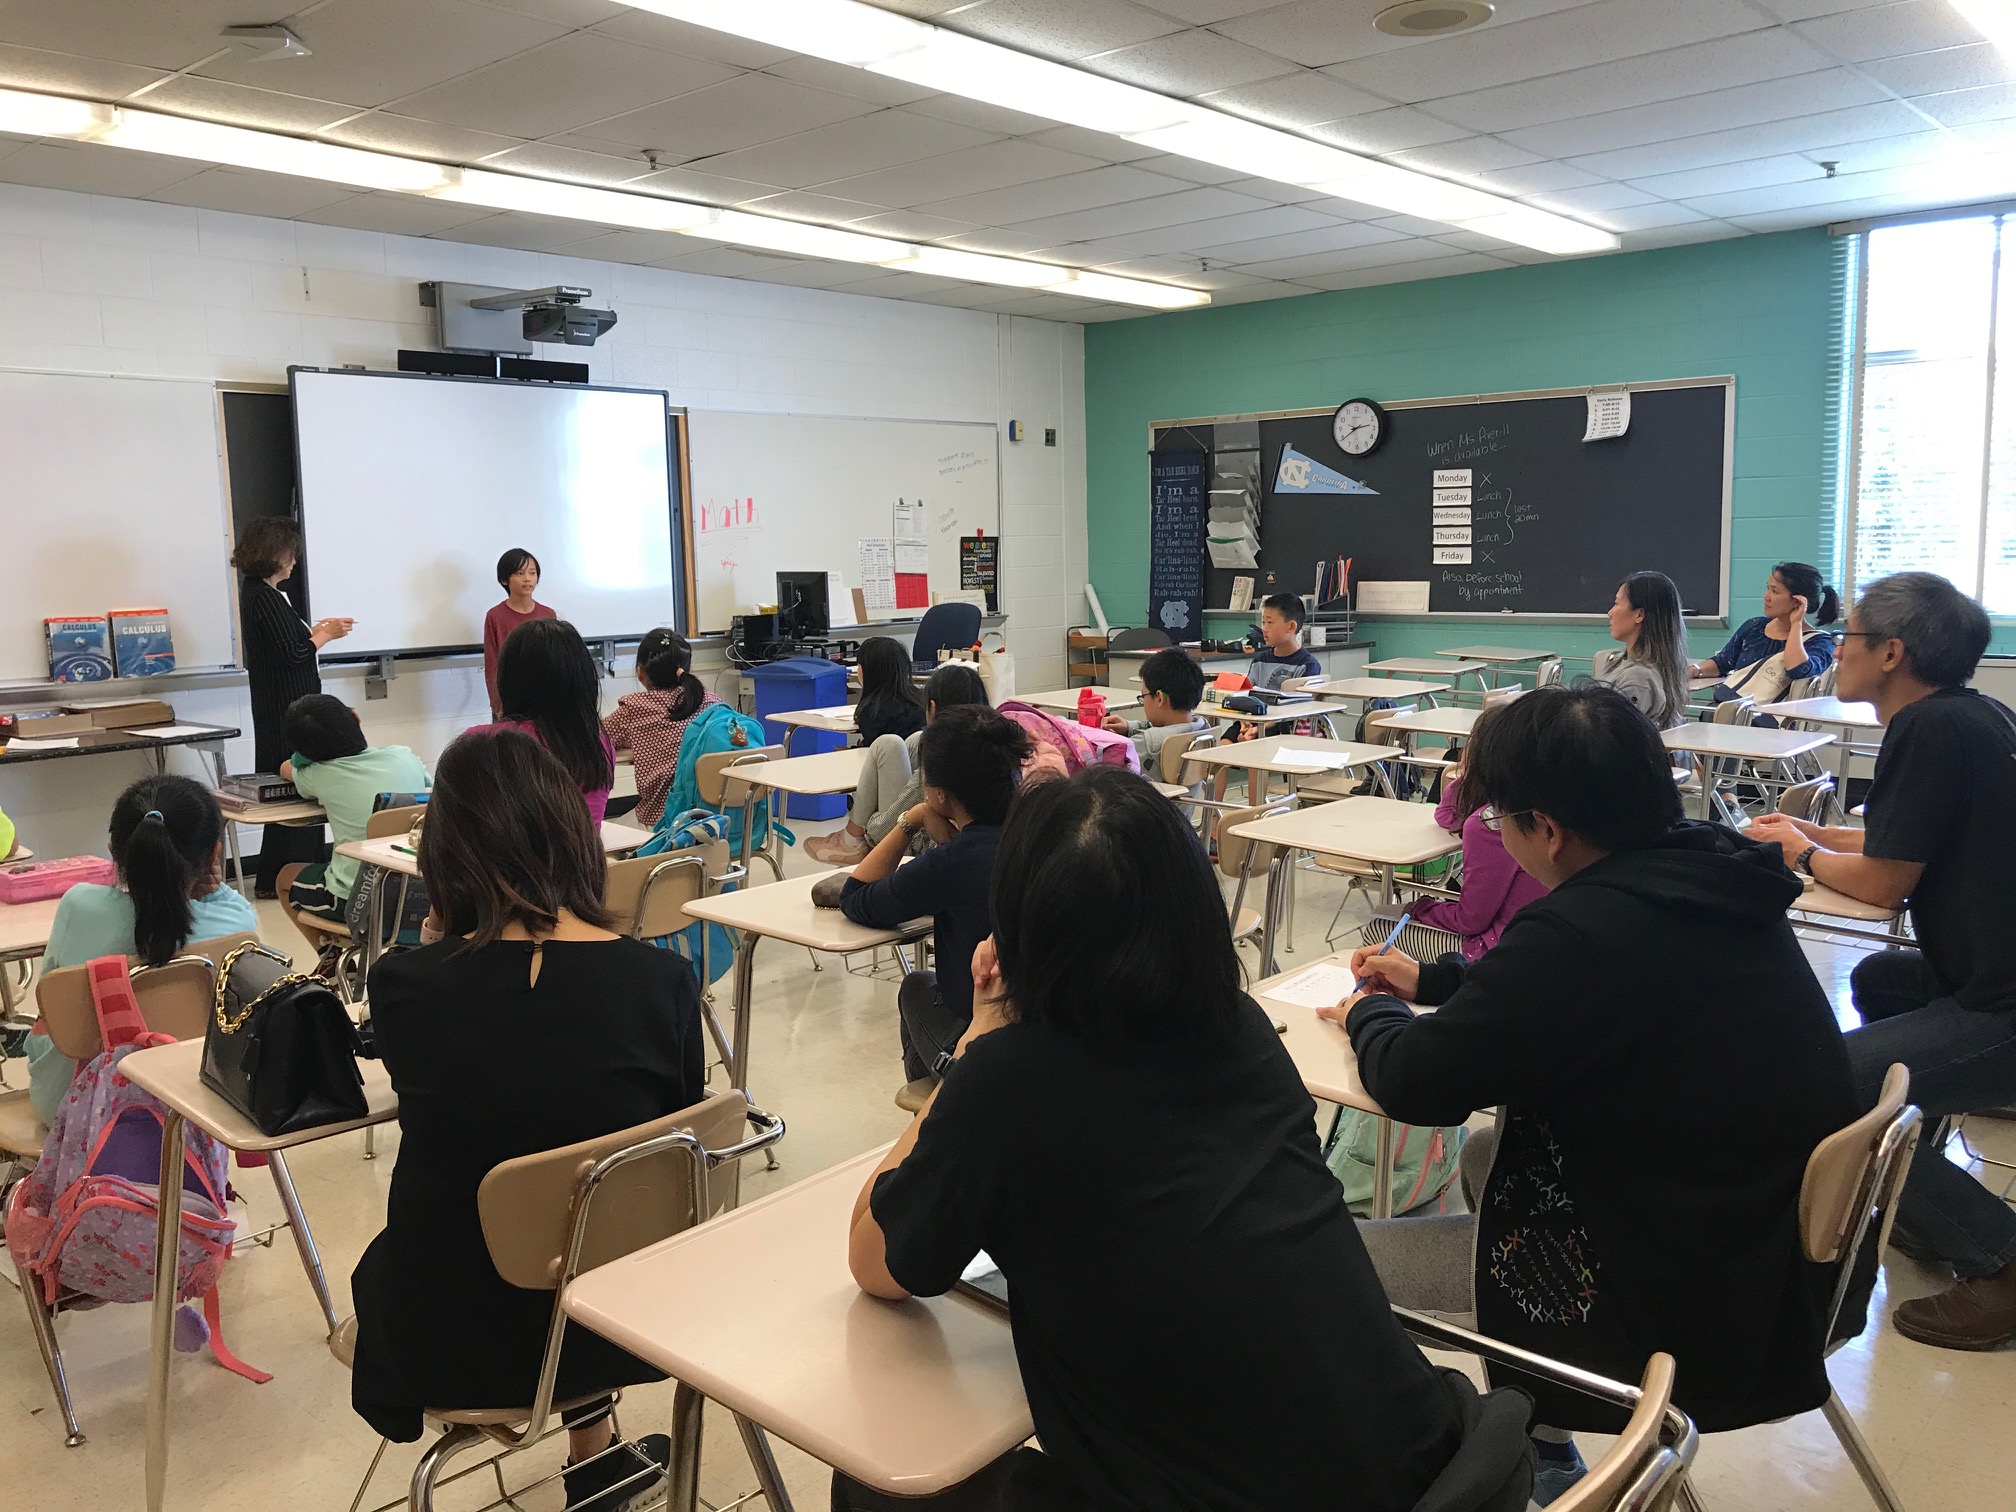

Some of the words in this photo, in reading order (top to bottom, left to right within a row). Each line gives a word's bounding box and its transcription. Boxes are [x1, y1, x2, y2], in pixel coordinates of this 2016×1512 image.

[1426, 440, 1454, 457] When
[1441, 456, 1450, 466] is
[1438, 475, 1468, 483] Monday
[1156, 486, 1183, 495] I'm
[1190, 486, 1199, 495] a
[1437, 493, 1467, 502] Tuesday
[1477, 490, 1501, 502] Lunch
[702, 498, 759, 530] Math
[1155, 505, 1183, 514] I'm
[1189, 506, 1199, 514] a
[1476, 509, 1502, 520] Lunch
[1436, 532, 1469, 540] Thursday
[1441, 552, 1464, 561] Friday
[1495, 570, 1522, 583] school
[1459, 585, 1470, 601] by
[62, 623, 97, 631] CALCULUS
[122, 625, 167, 635] CALCULUS
